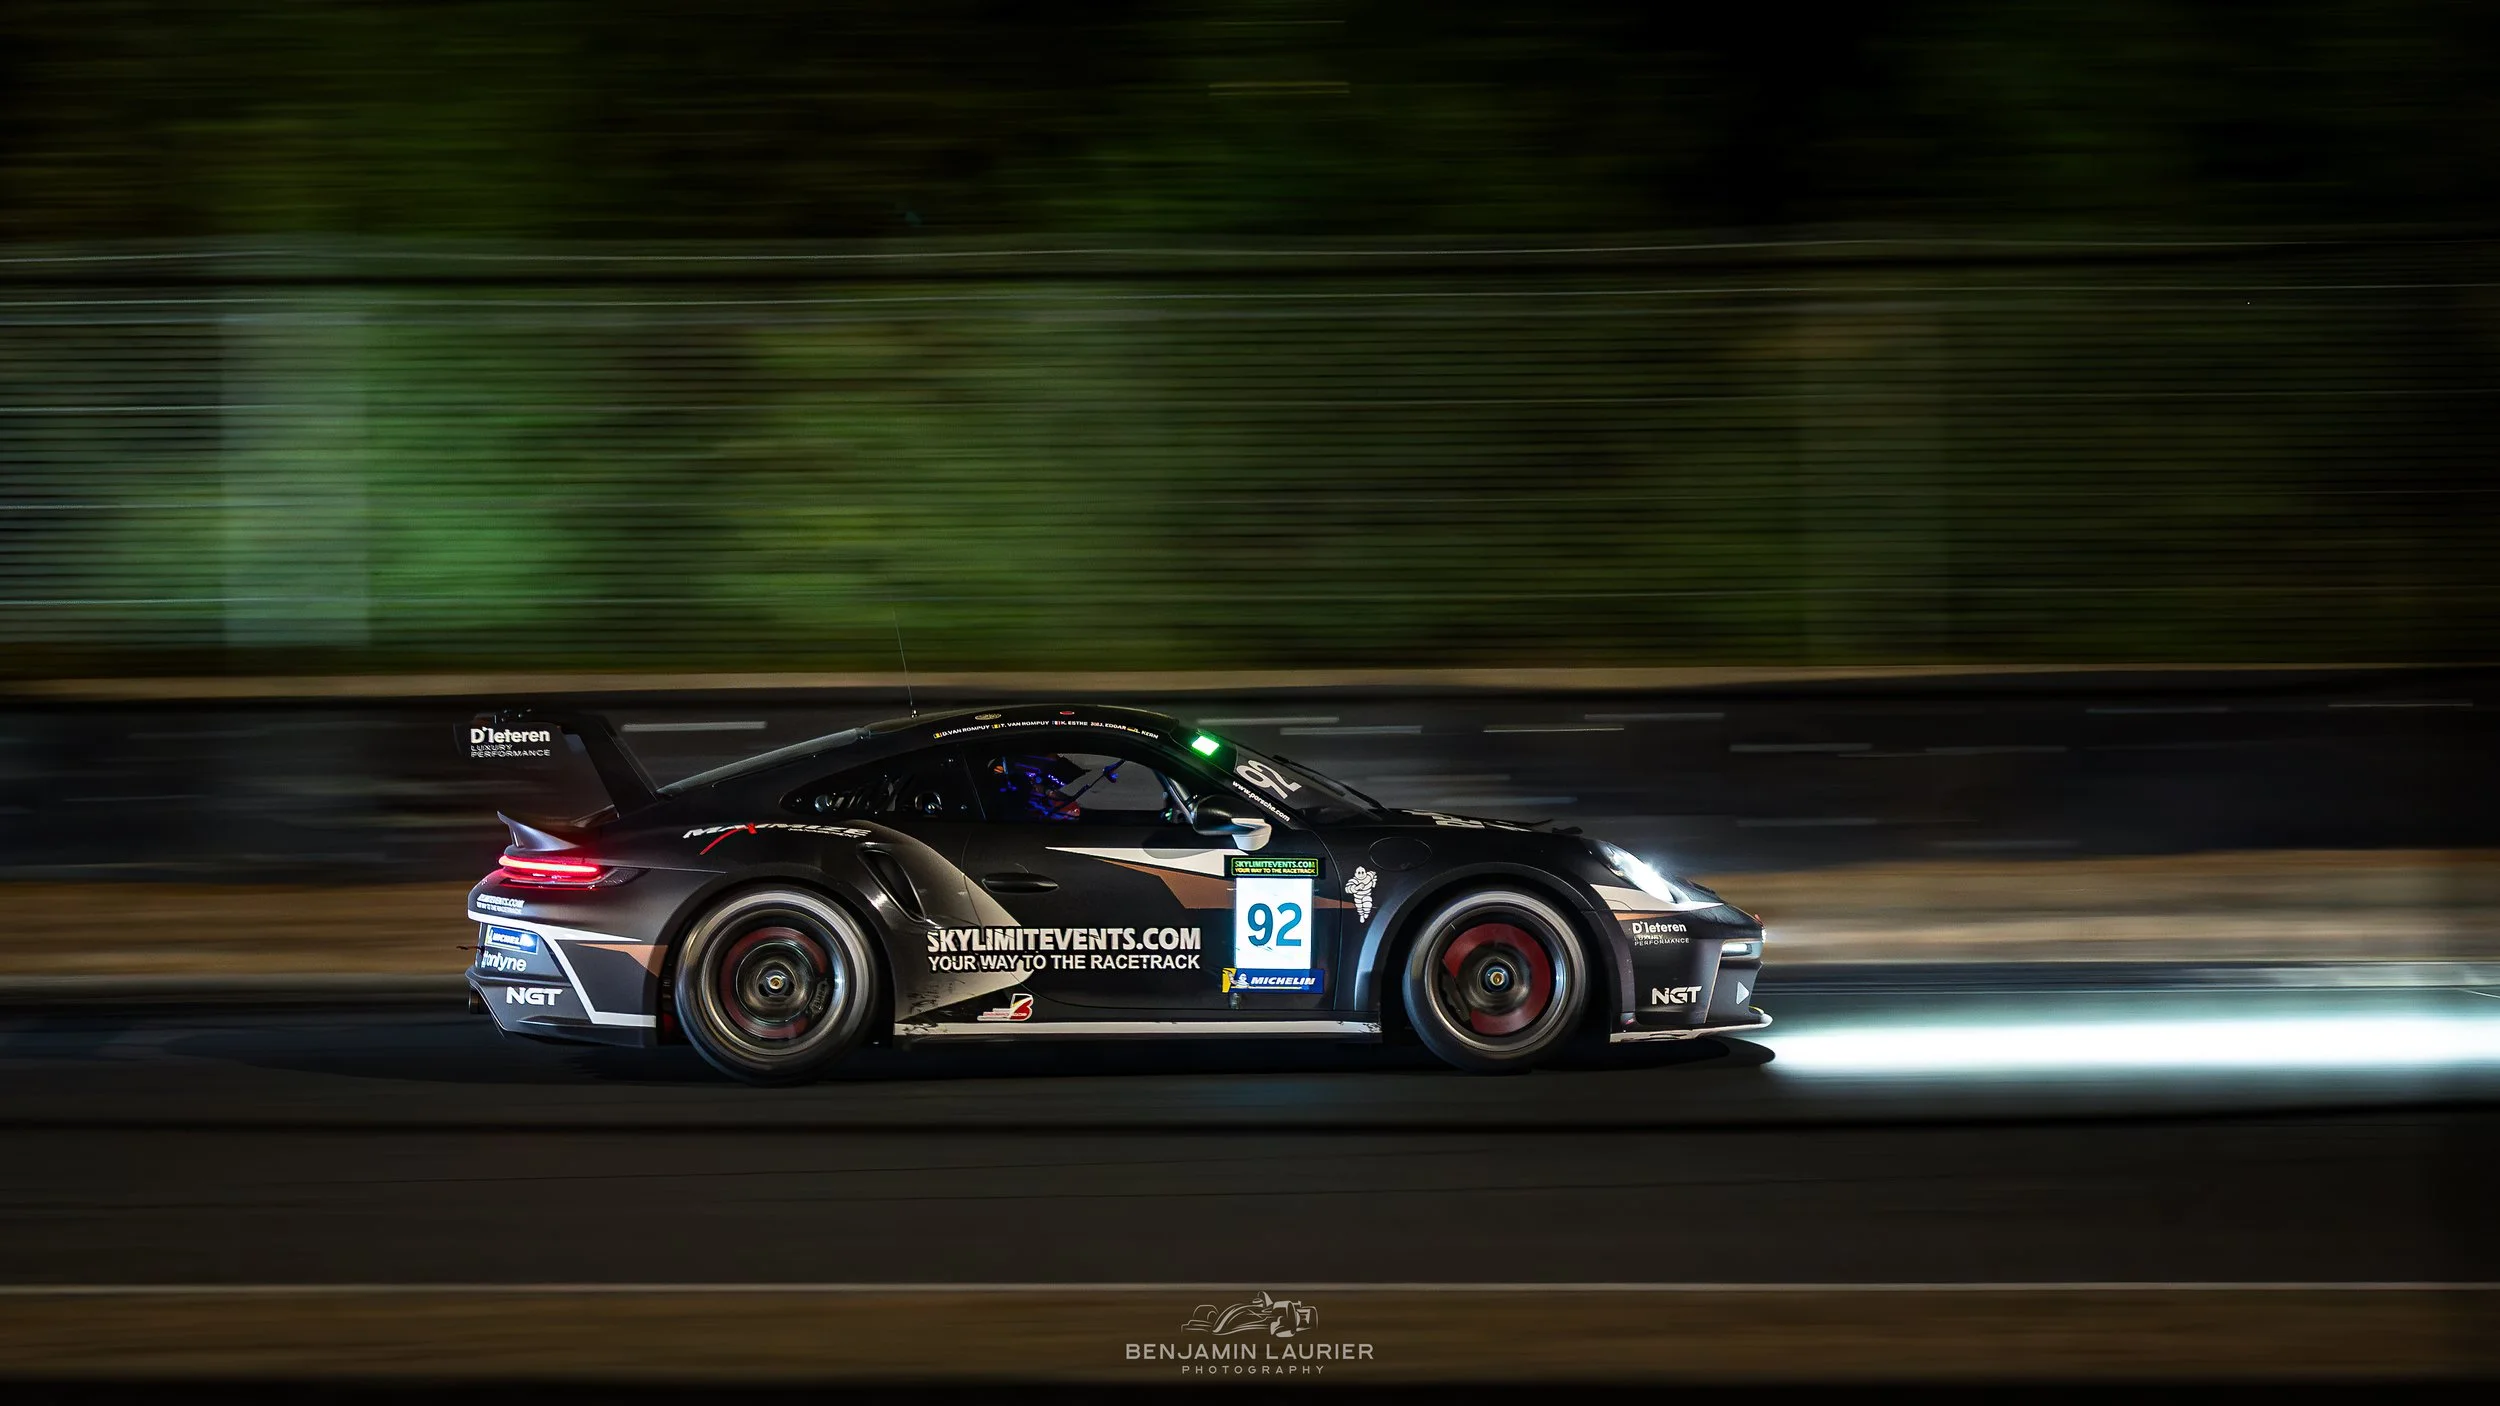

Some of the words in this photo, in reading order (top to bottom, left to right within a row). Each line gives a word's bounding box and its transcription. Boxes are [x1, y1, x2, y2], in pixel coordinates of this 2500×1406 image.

[470, 744, 513, 752] LUXURY
[470, 749, 551, 758] PERFORMANCE
[1236, 760, 1302, 799] 92
[1232, 780, 1291, 822] www.porsche.com
[1247, 902, 1302, 947] 92
[926, 927, 1202, 952] SKYLIMITEVENTS.COM
[1634, 937, 1690, 946] PERFORMANCE
[927, 955, 977, 972] YOUR
[979, 954, 1018, 970] WAY
[1022, 954, 1047, 970] TO
[1051, 954, 1087, 970] THE
[1090, 954, 1201, 970] RACETRACK
[1250, 976, 1316, 986] MICHELIN
[506, 986, 564, 1006] NGT
[1651, 986, 1702, 1005] NGT
